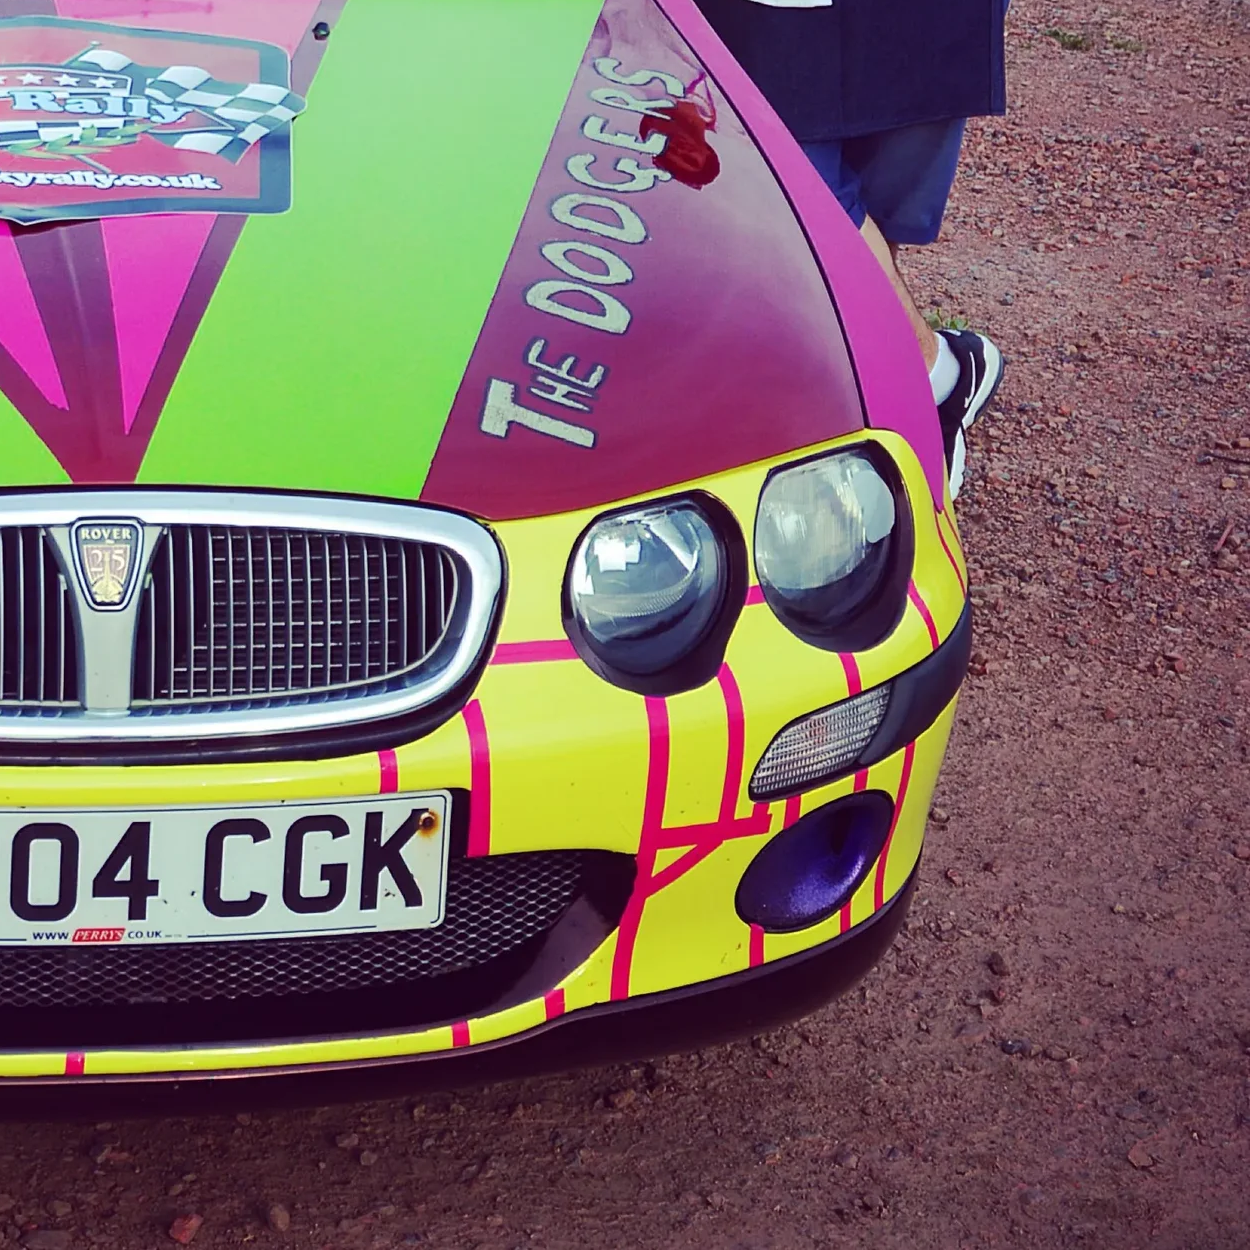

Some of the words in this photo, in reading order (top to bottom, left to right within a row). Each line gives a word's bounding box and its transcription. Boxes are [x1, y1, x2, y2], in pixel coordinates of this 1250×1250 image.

[6, 88, 192, 126] Rally
[525, 57, 687, 335] DODGERS
[479, 338, 605, 449] THE
[81, 528, 132, 540] ROVER
[90, 549, 126, 572] 25
[200, 807, 427, 916] CGK
[32, 931, 69, 940] WWW
[73, 928, 124, 941] PERRYS
